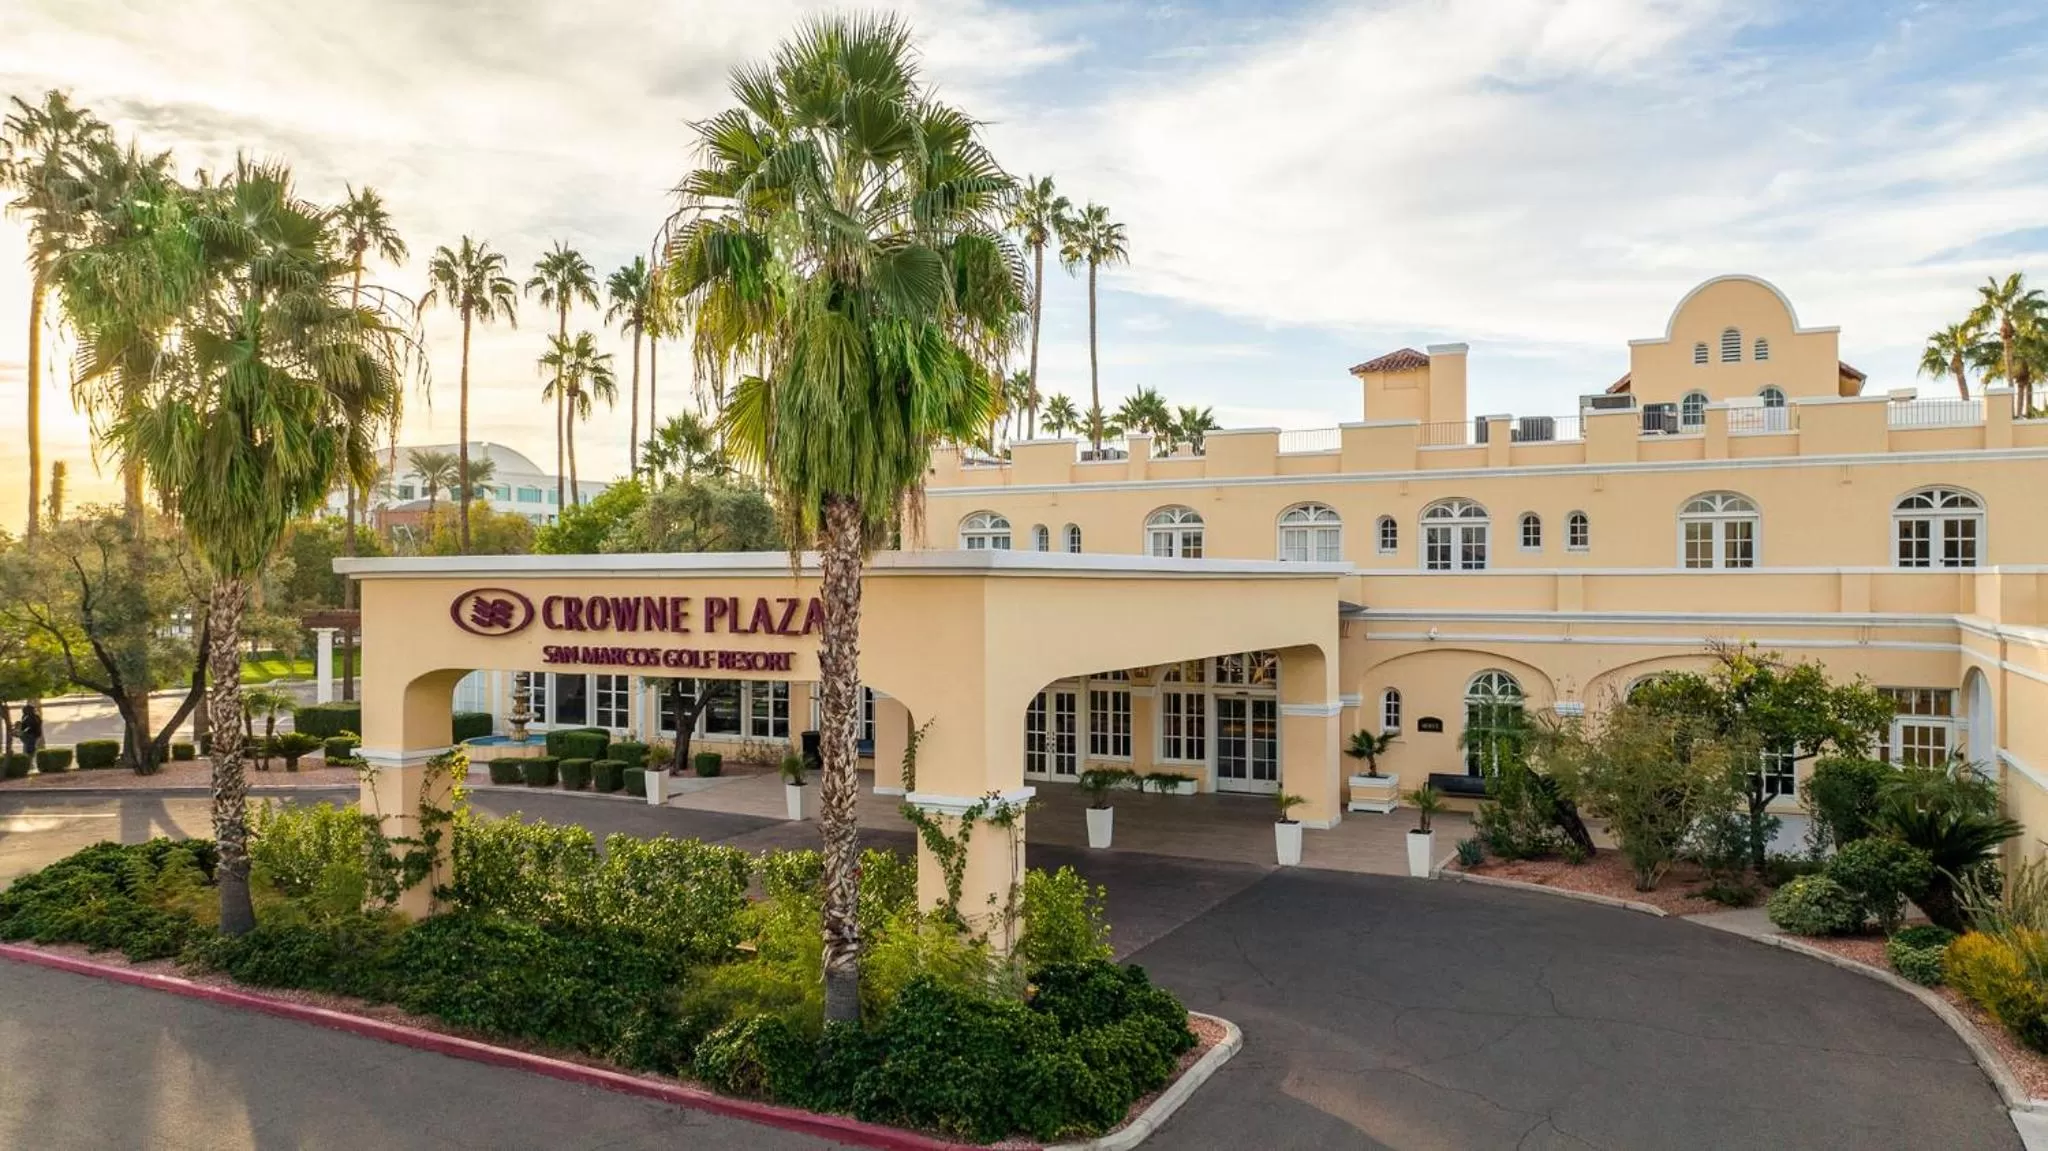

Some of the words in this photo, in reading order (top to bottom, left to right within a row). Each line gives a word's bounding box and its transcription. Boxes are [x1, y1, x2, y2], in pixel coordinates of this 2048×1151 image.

[542, 596, 691, 633] CROWNE
[704, 597, 825, 636] PLAZA
[543, 645, 580, 664] SAN
[581, 647, 662, 667] MARCOS
[662, 650, 716, 669] GOLF
[717, 651, 797, 671] RESORT
